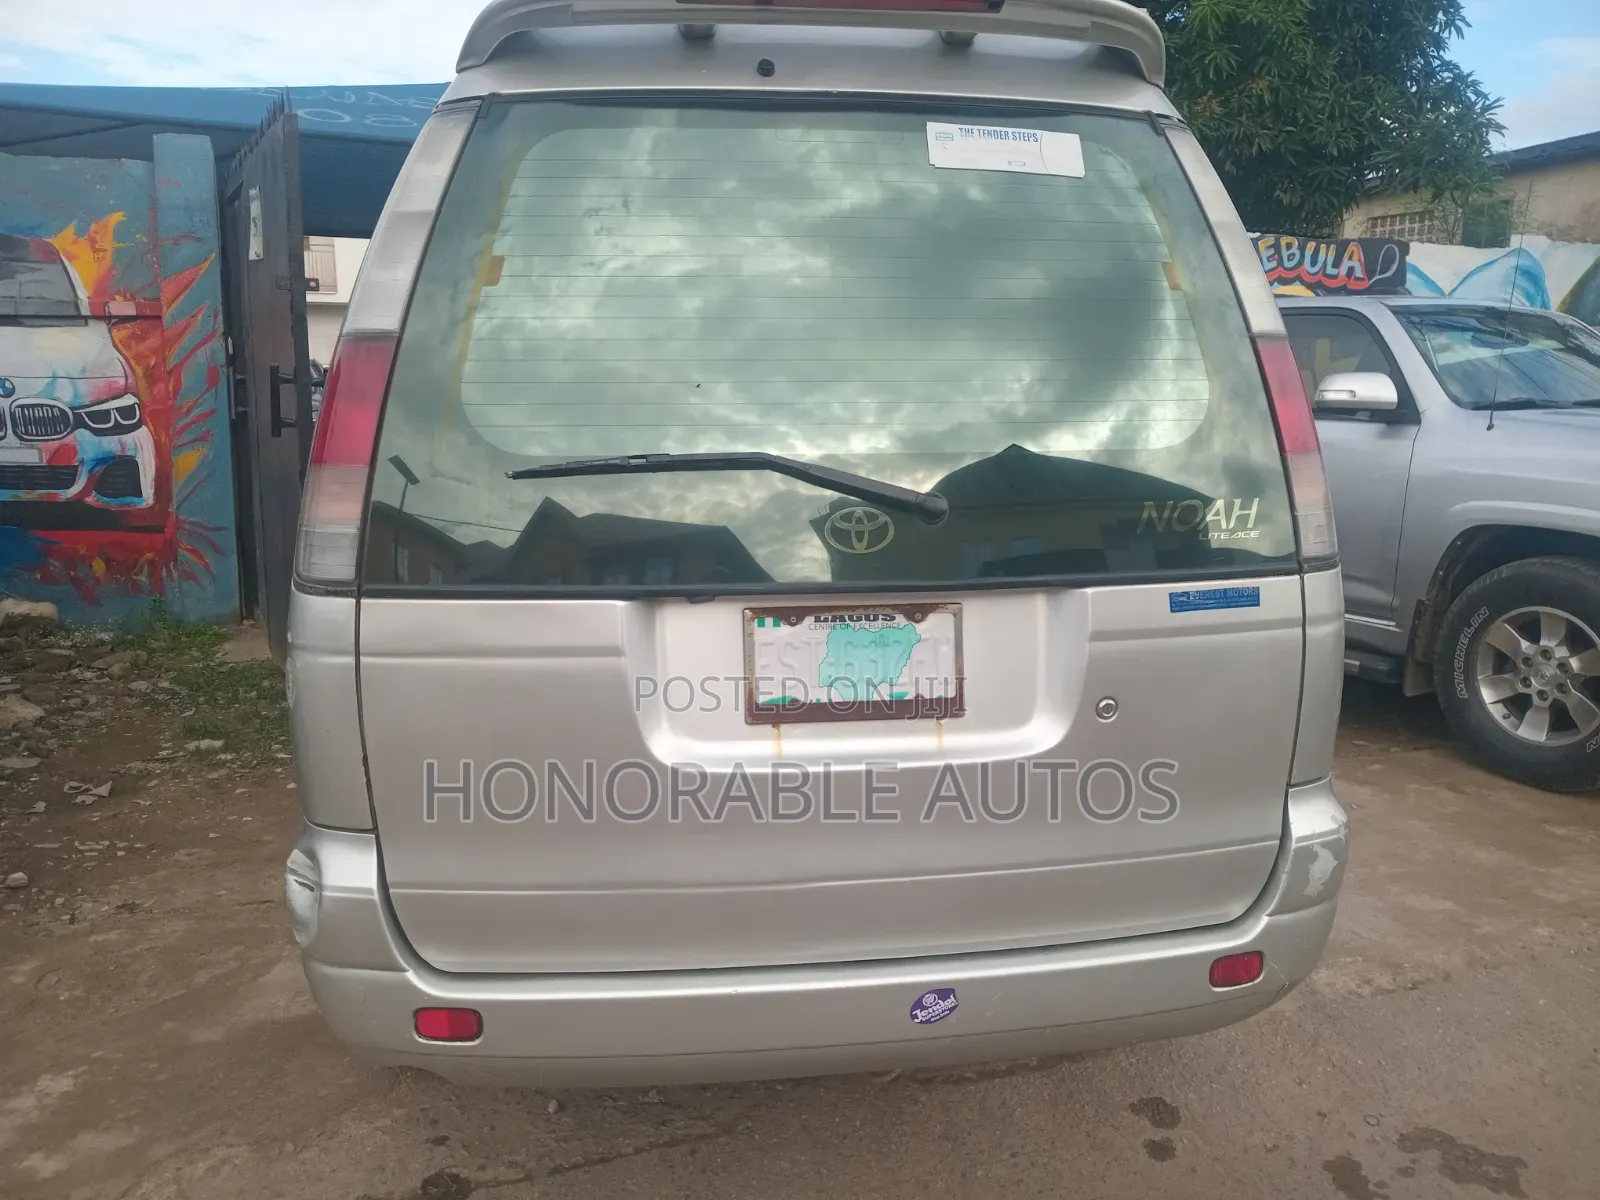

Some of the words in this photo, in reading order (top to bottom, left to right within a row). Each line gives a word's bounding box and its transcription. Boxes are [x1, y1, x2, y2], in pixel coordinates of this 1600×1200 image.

[958, 127, 975, 138] THE
[976, 128, 1010, 141] TENDER
[1011, 131, 1039, 143] STEPS
[1136, 497, 1260, 533] NOAH
[1226, 586, 1258, 597] MOTORS
[808, 622, 837, 631] CENTRE
[839, 622, 852, 630] OF
[853, 621, 902, 630] EXCELLENCE
[1453, 606, 1490, 699] MICHELIN
